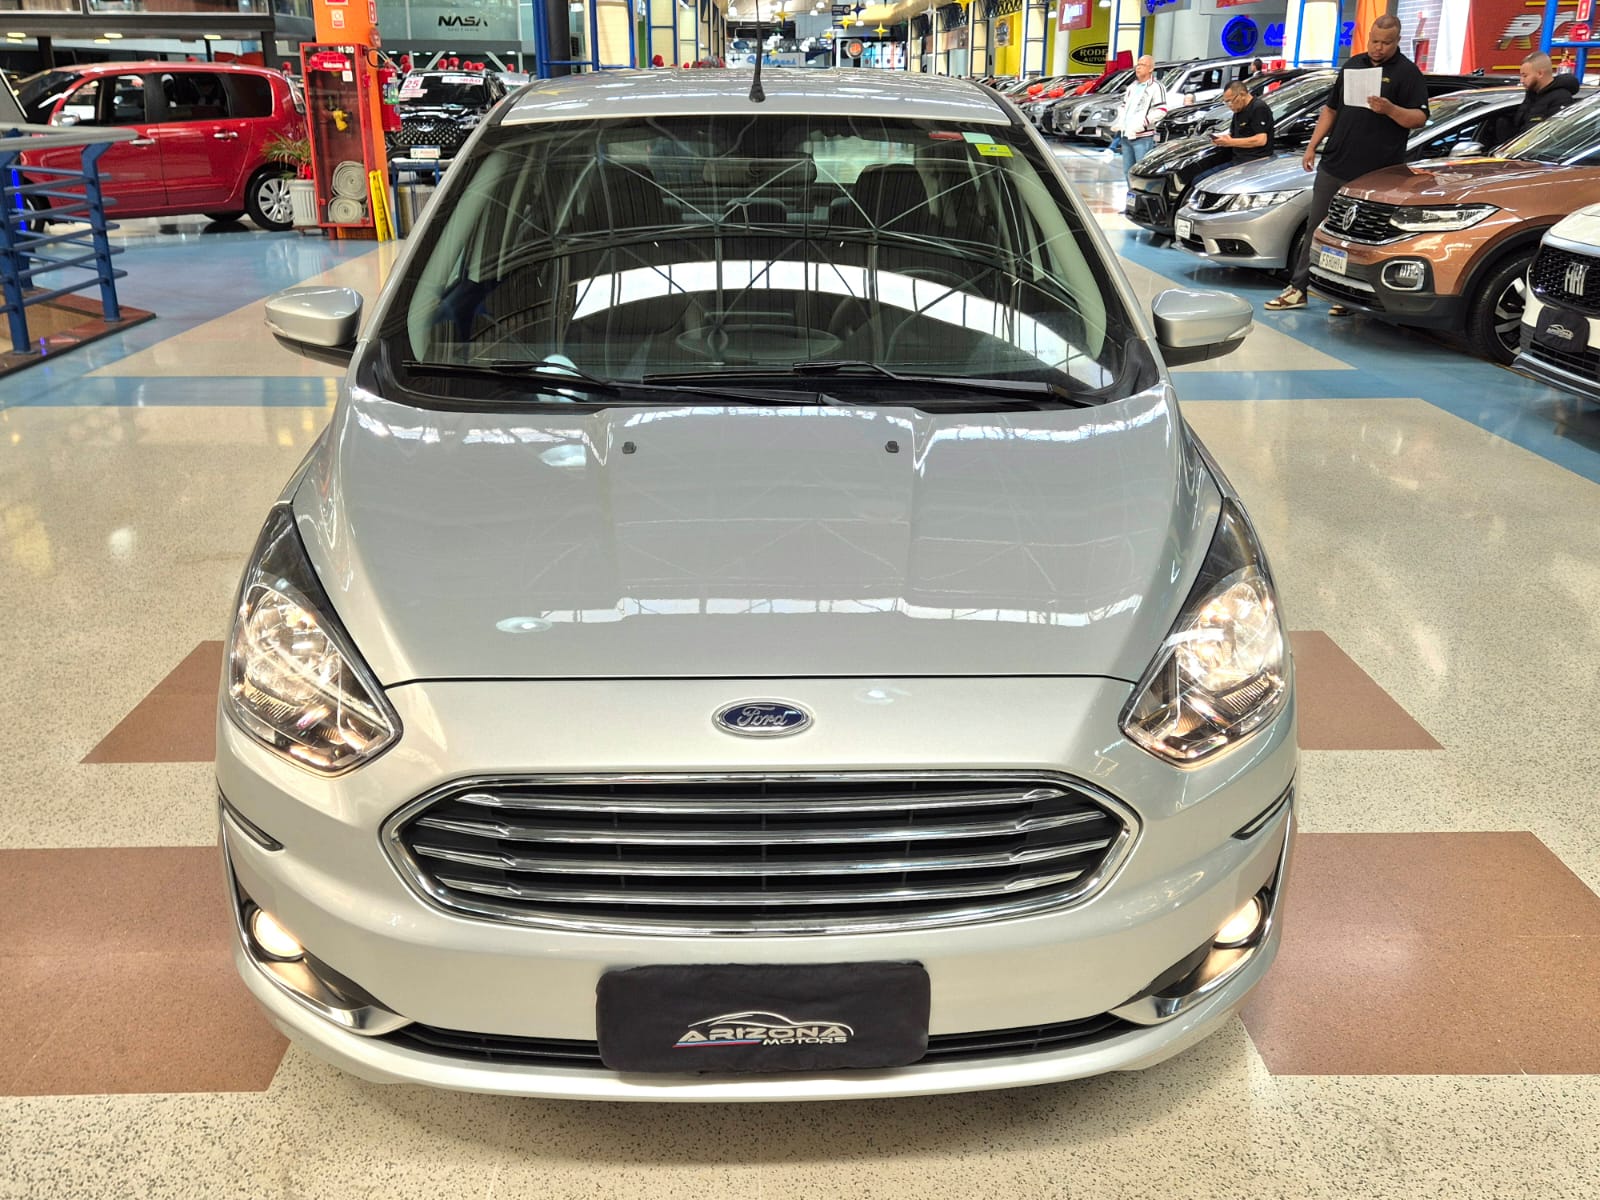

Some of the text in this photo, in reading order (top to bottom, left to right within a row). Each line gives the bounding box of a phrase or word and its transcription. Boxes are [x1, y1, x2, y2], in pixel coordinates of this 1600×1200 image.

[438, 15, 488, 27] NASA
[736, 705, 788, 727] Ford
[676, 1026, 848, 1042] ARIZONA
[762, 1036, 848, 1046] MOTORS
